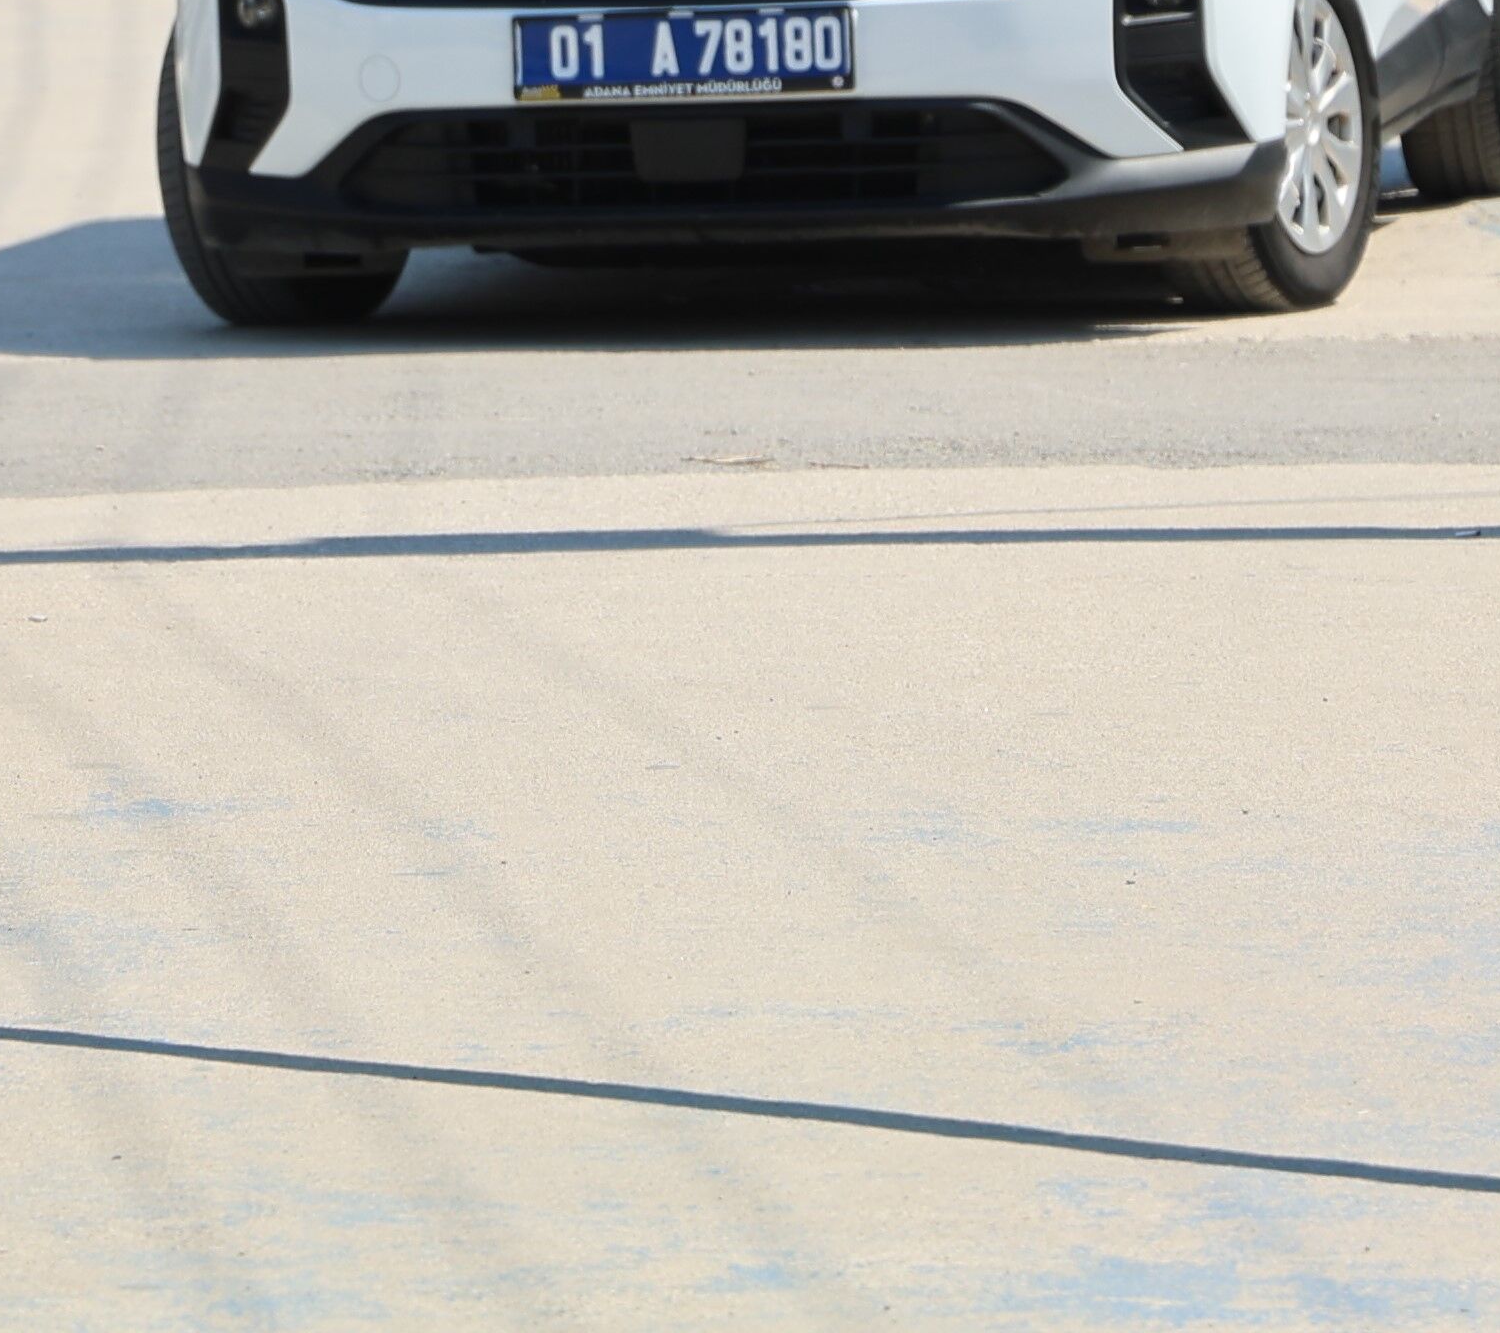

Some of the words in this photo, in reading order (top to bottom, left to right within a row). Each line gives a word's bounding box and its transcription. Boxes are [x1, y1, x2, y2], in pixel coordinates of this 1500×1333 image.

[550, 24, 605, 81] 01
[651, 18, 681, 78] A
[694, 14, 844, 77] 78180
[583, 86, 632, 99] ADANA
